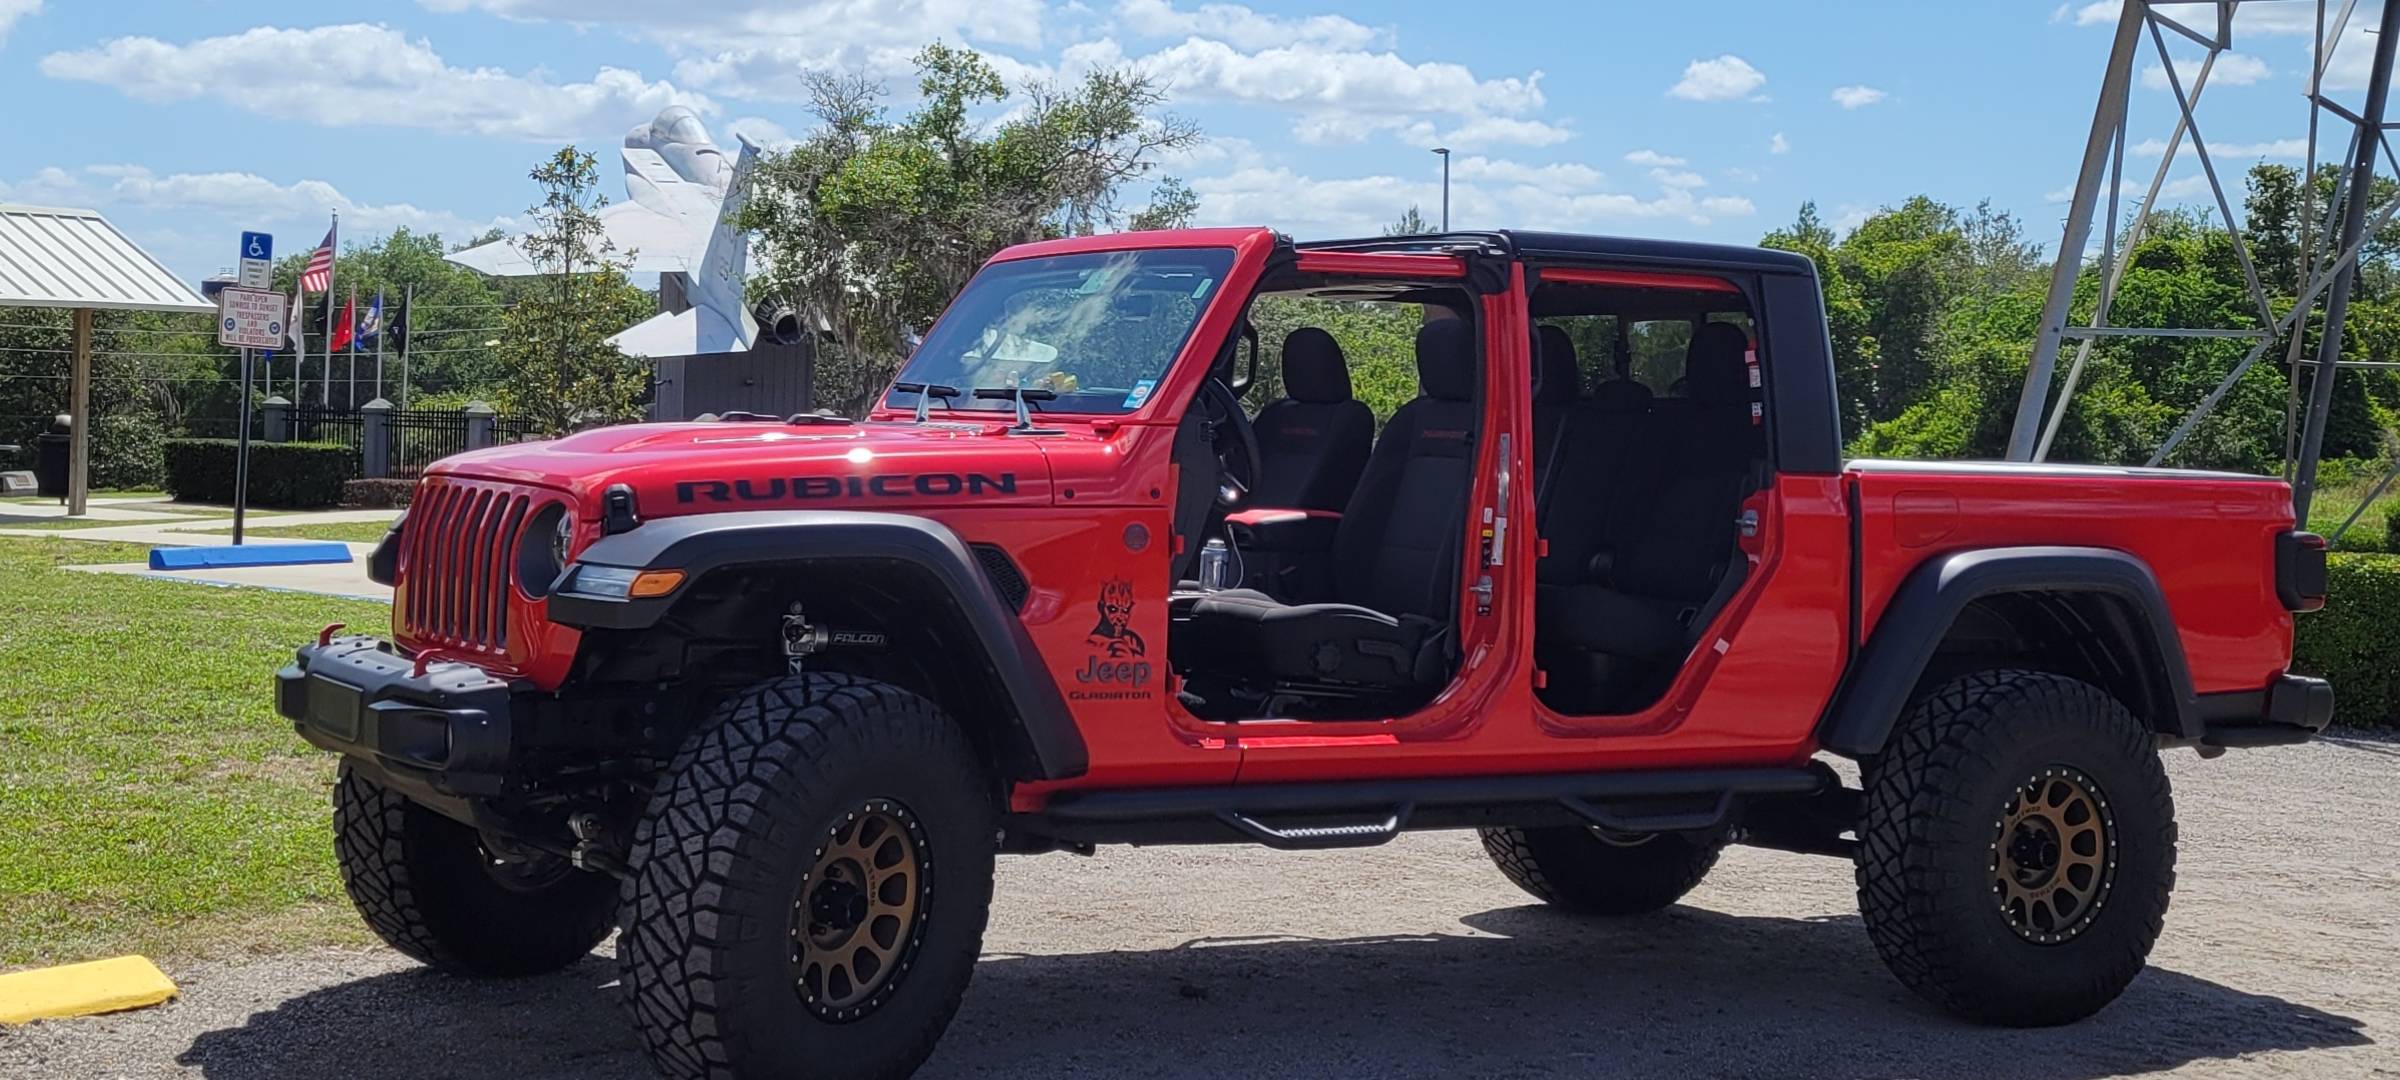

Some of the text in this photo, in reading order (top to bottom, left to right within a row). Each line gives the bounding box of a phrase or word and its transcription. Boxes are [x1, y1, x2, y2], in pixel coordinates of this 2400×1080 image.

[240, 293, 268, 303] PARK OPEN
[259, 304, 278, 312] SUNSET
[237, 311, 269, 321] TRESPASSERS
[247, 320, 257, 328] AND
[676, 472, 1016, 504] RUBICON
[833, 633, 885, 643] FALCON
[1076, 655, 1152, 688] Jeep
[1069, 691, 1152, 700] GLADIATOR
